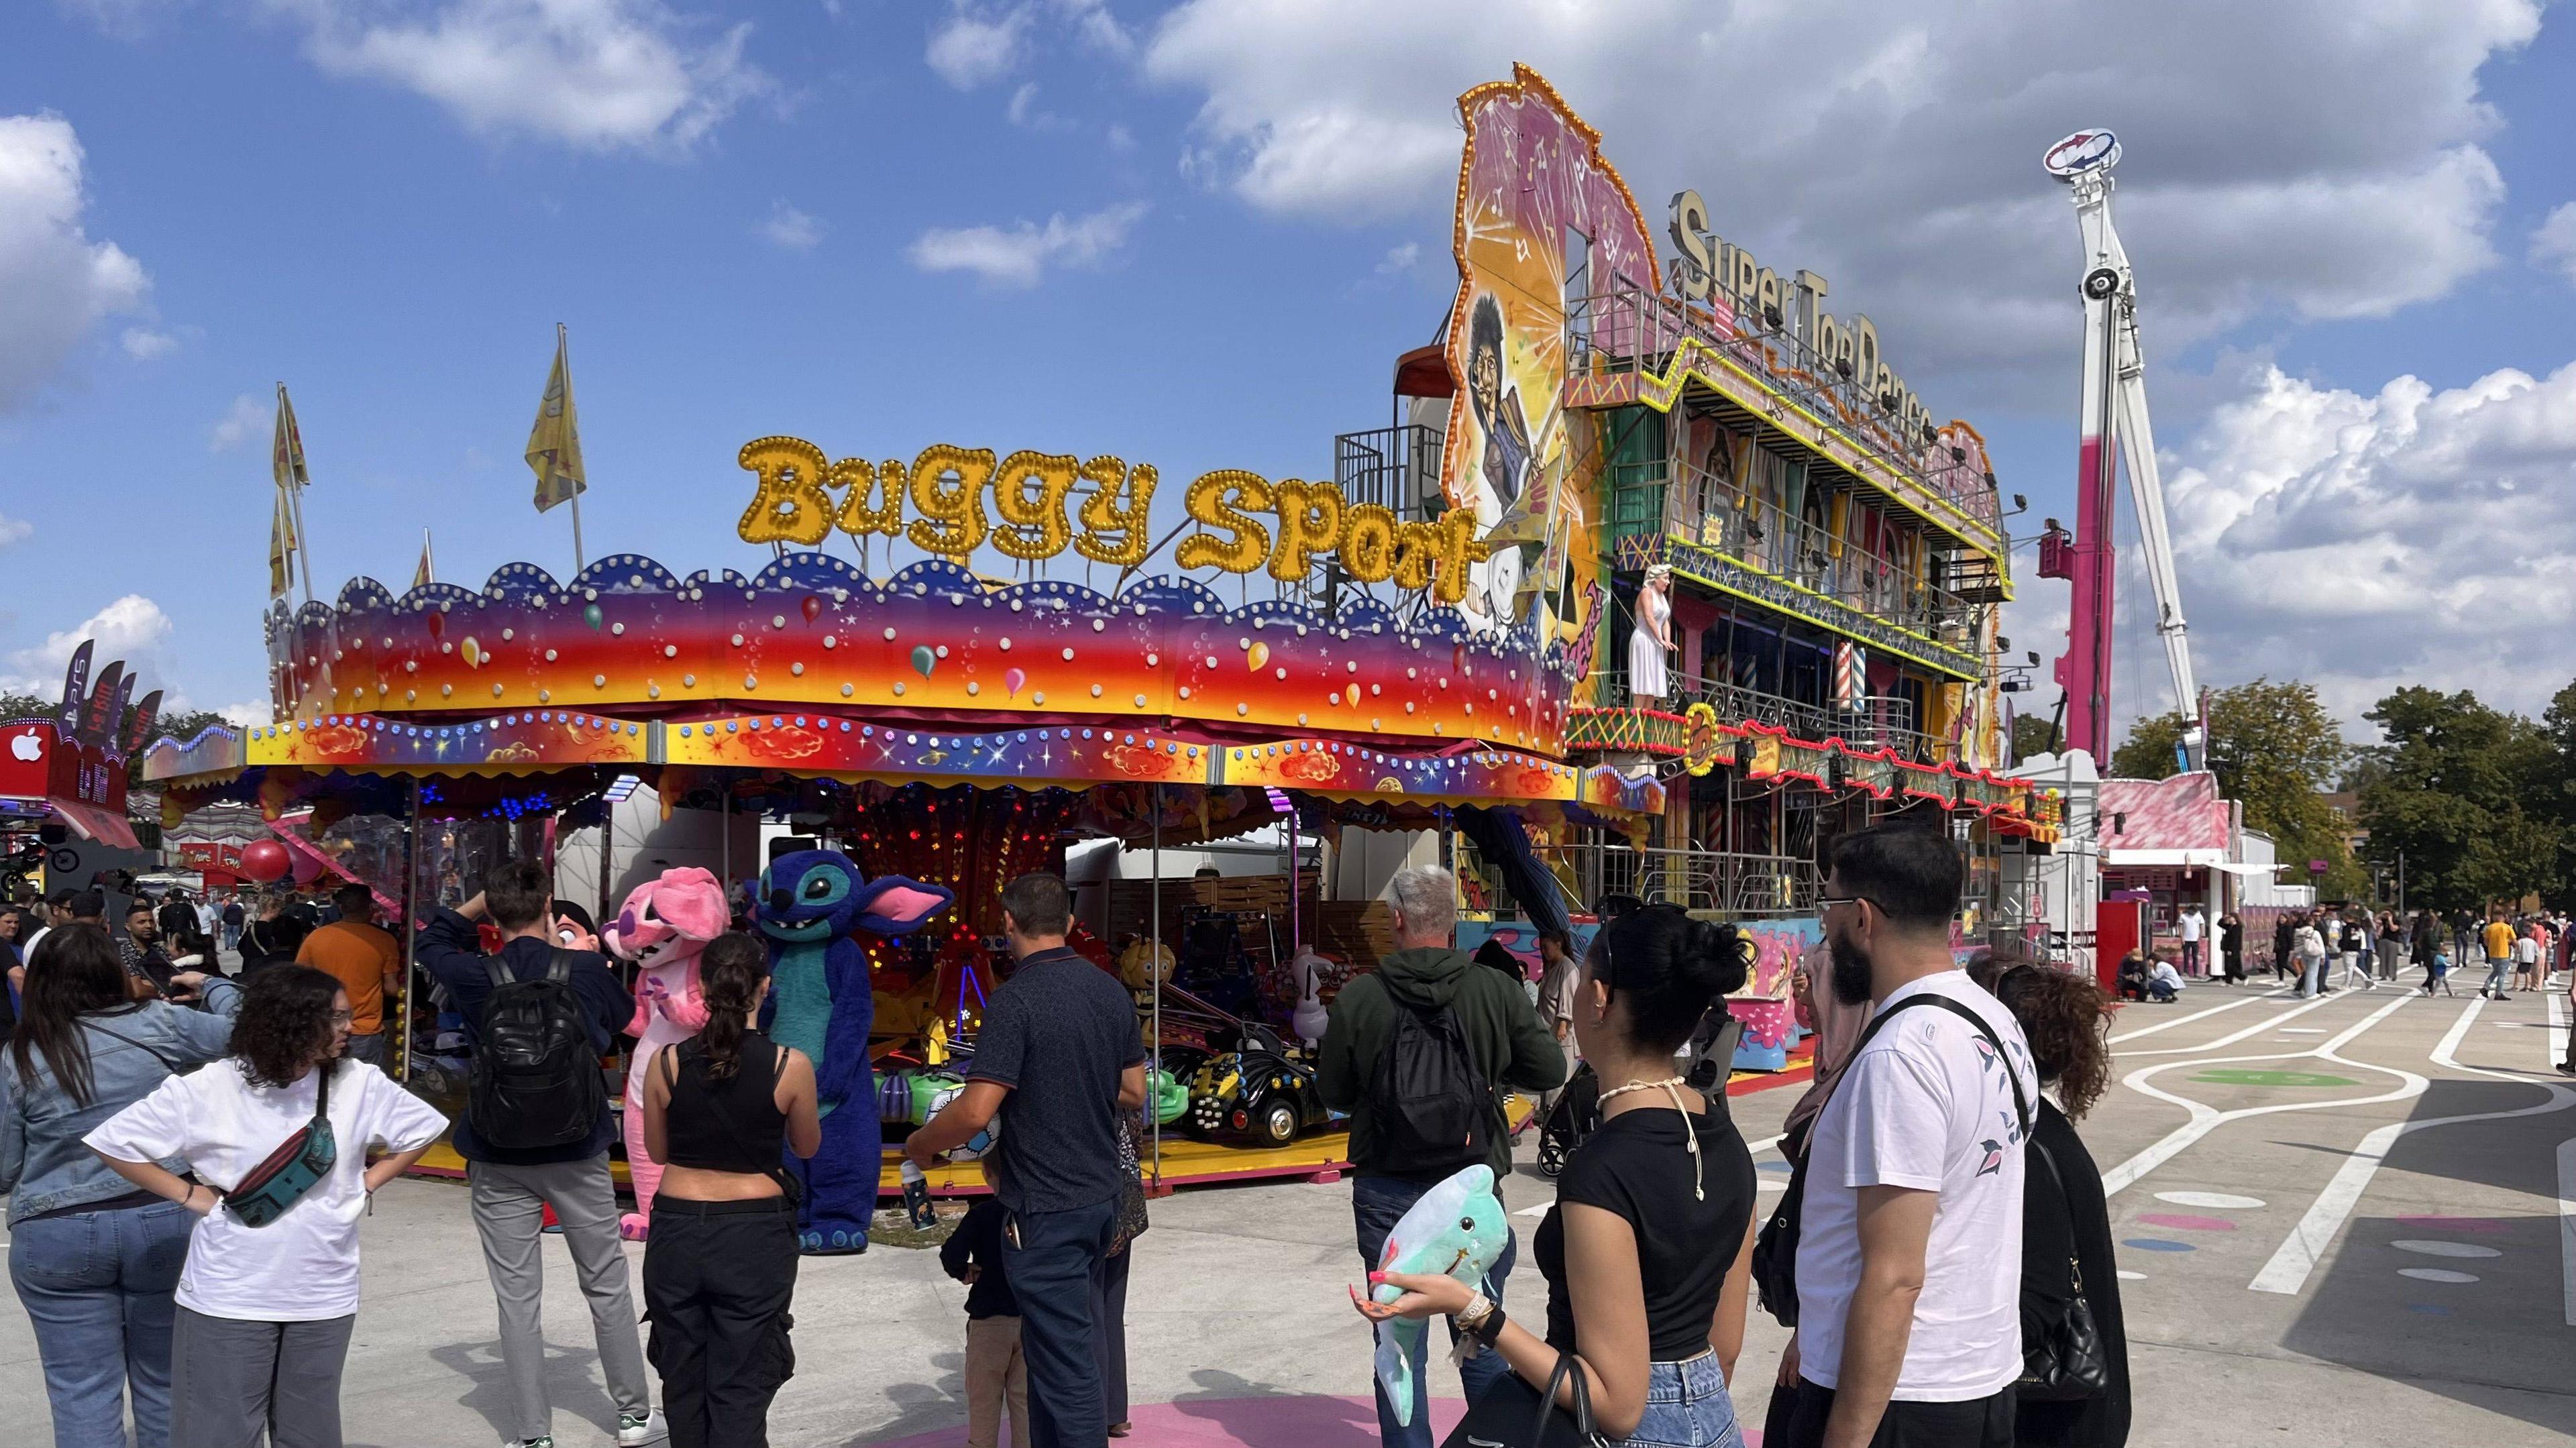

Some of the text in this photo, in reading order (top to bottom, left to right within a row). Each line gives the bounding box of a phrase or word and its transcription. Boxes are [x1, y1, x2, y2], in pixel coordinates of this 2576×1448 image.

[738, 435, 1490, 603] Buggy Sport
[70, 658, 86, 705] PS5
[1466, 1299, 1483, 1319] LOVE
